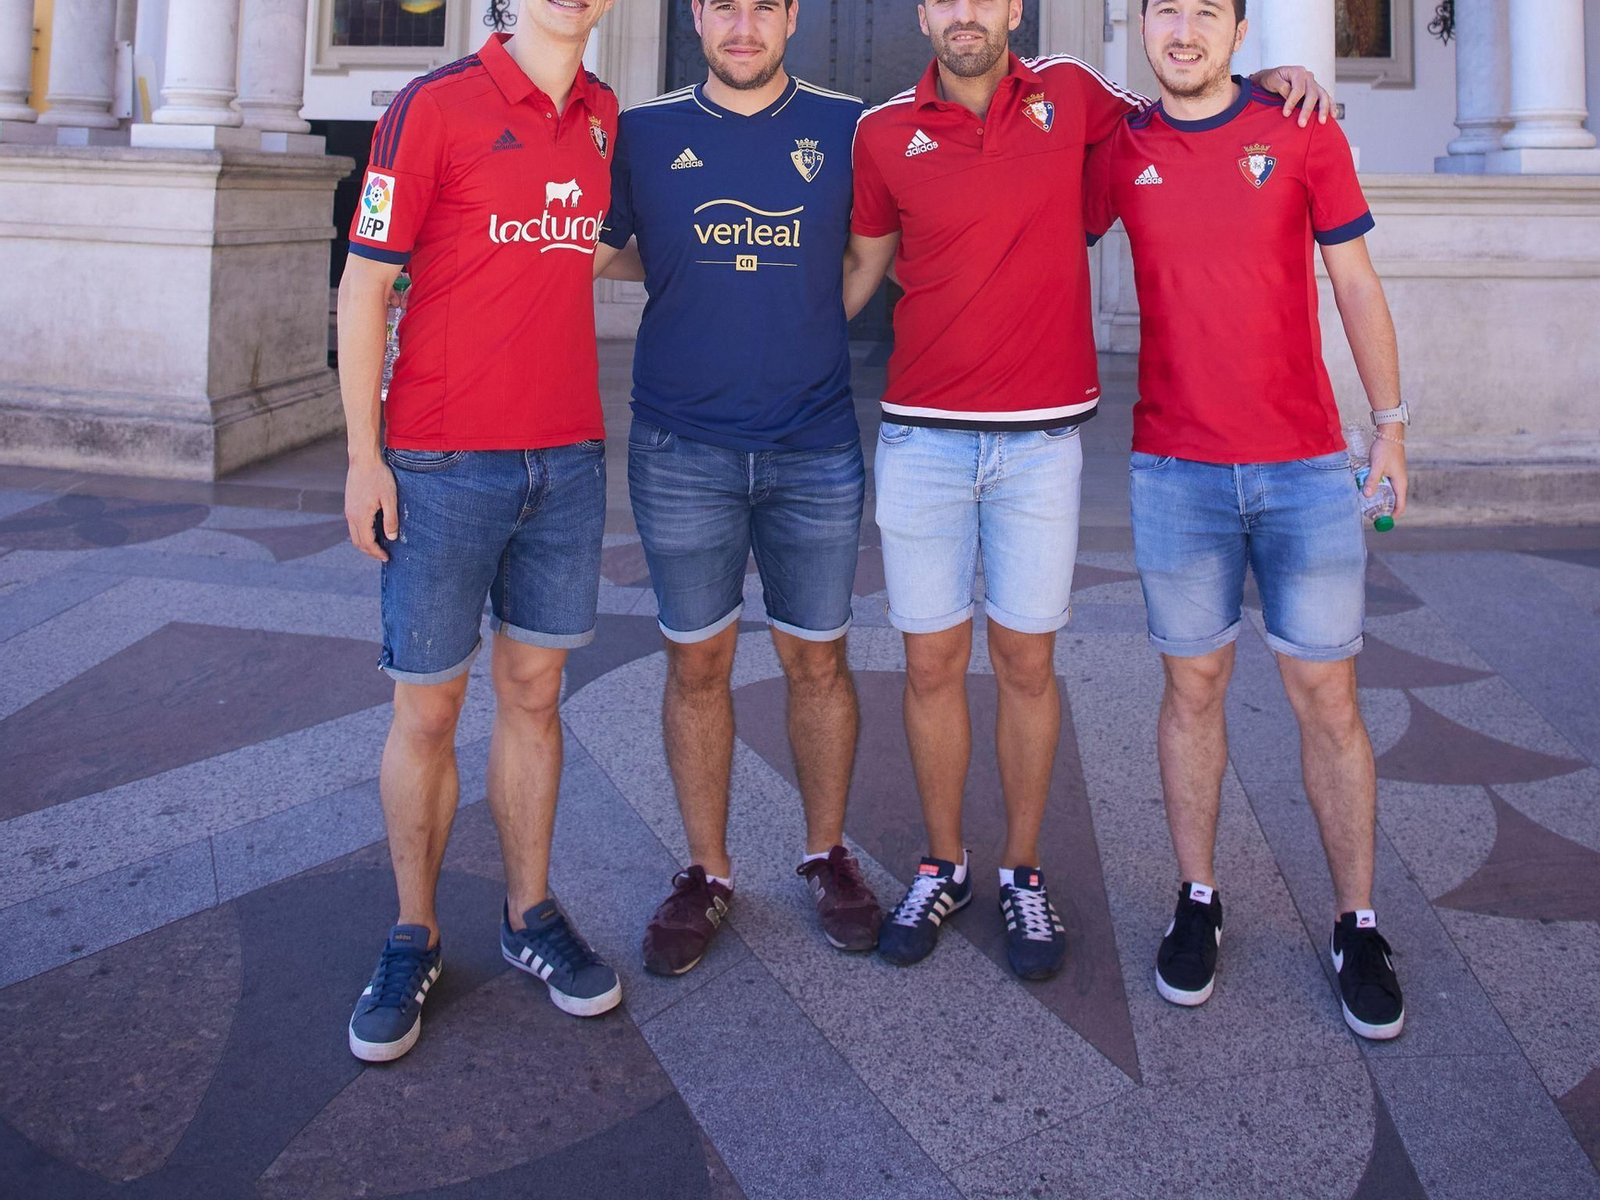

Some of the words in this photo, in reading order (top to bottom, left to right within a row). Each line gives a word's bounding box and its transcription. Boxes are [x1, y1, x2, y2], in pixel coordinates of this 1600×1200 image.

[905, 141, 938, 157] adidas
[671, 159, 704, 170] adidas
[1134, 177, 1163, 186] adidas
[359, 215, 384, 237] LFP
[693, 217, 800, 247] verleal
[739, 258, 753, 268] cn
